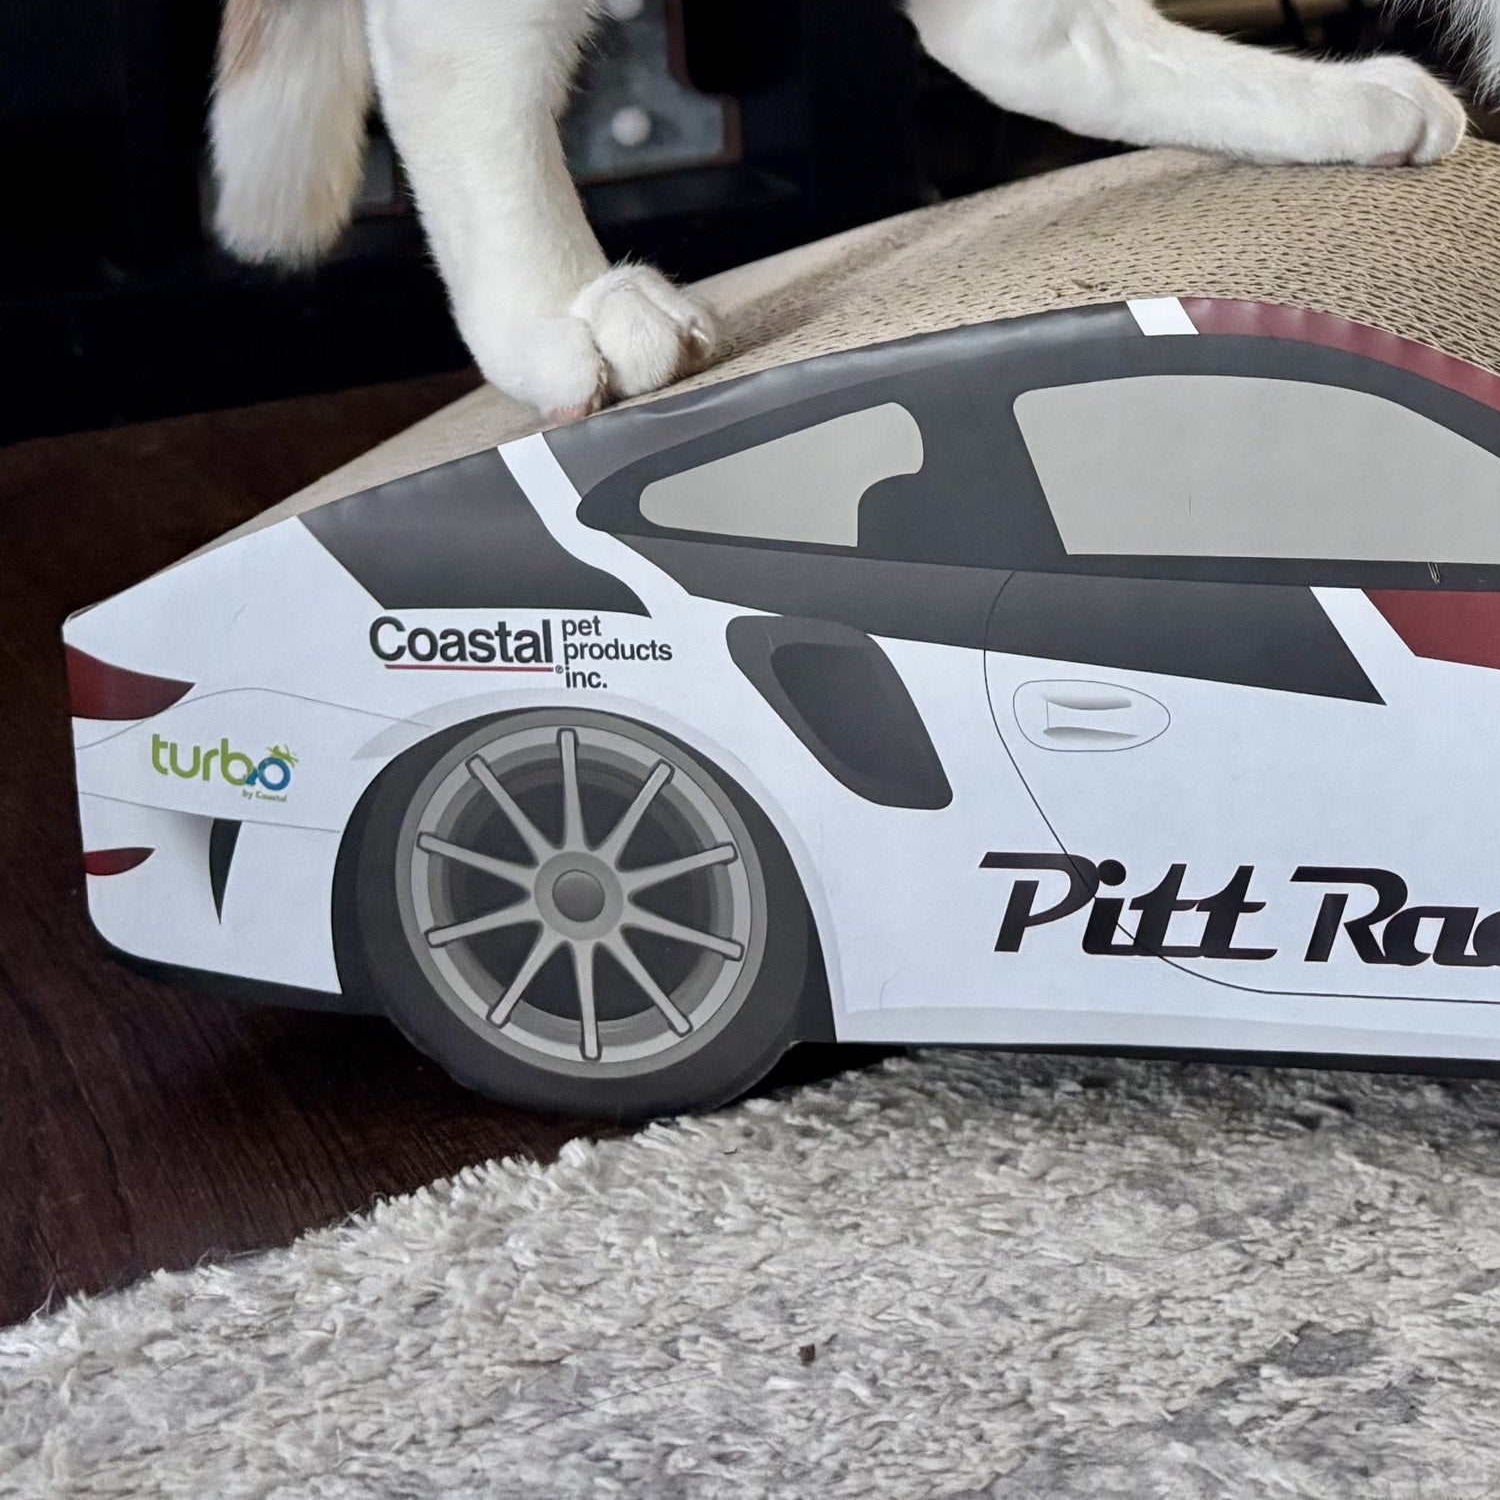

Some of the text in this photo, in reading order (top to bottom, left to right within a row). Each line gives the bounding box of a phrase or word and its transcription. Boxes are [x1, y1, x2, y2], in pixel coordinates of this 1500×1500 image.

[369, 615, 554, 664] Coastal
[562, 615, 602, 642] pet
[564, 638, 673, 665] products
[565, 666, 608, 689] inc.
[152, 733, 291, 791] turbo
[979, 851, 1277, 960] Pitt
